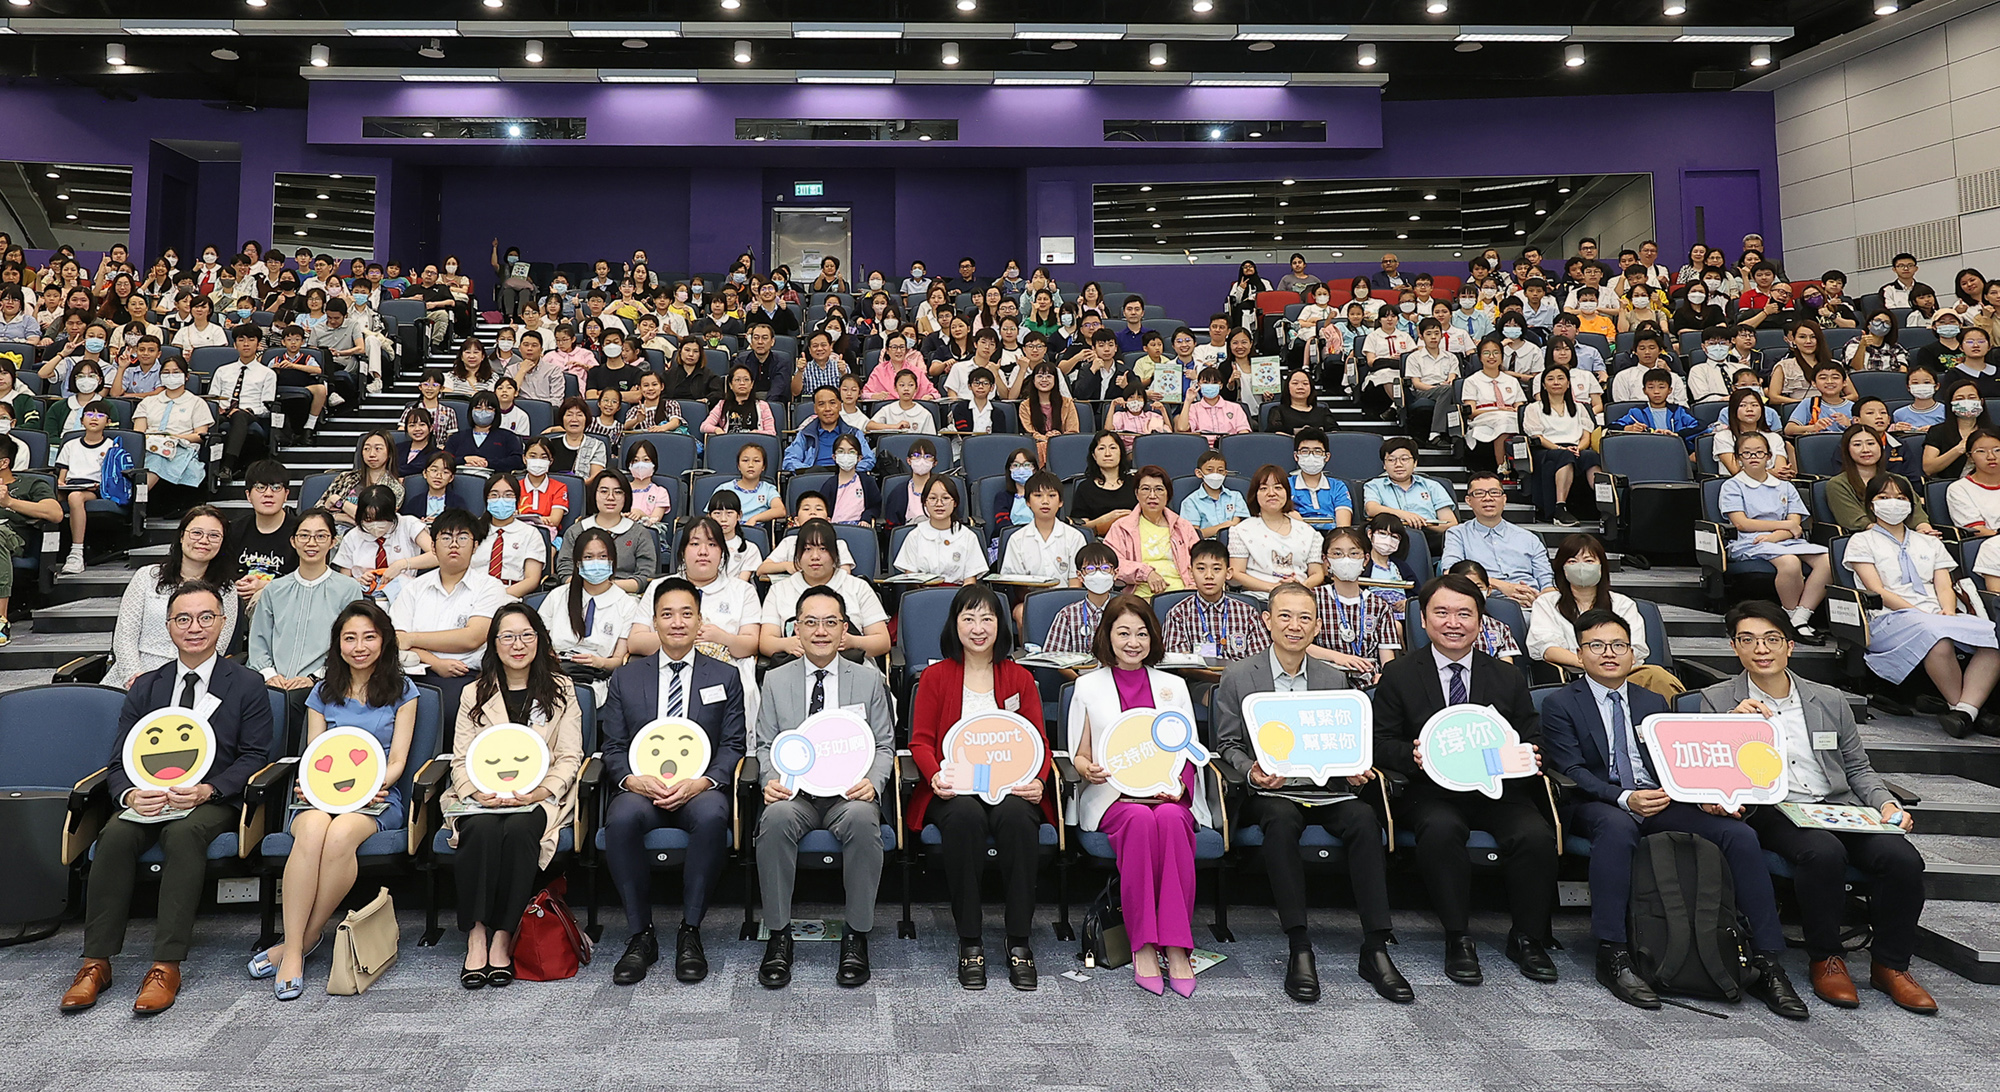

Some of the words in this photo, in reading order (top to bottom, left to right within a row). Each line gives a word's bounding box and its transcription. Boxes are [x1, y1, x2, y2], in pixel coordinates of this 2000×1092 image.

[796, 185, 810, 195] EXIT
[1298, 709, 1353, 727] 幫緊你
[815, 734, 867, 758] 好叻啊
[963, 728, 1023, 746] Support
[1302, 733, 1357, 751] 幫緊你
[1435, 721, 1497, 757] 撐你
[985, 750, 1012, 765] you
[1107, 740, 1158, 774] 支持你
[1671, 740, 1735, 768] 加油
